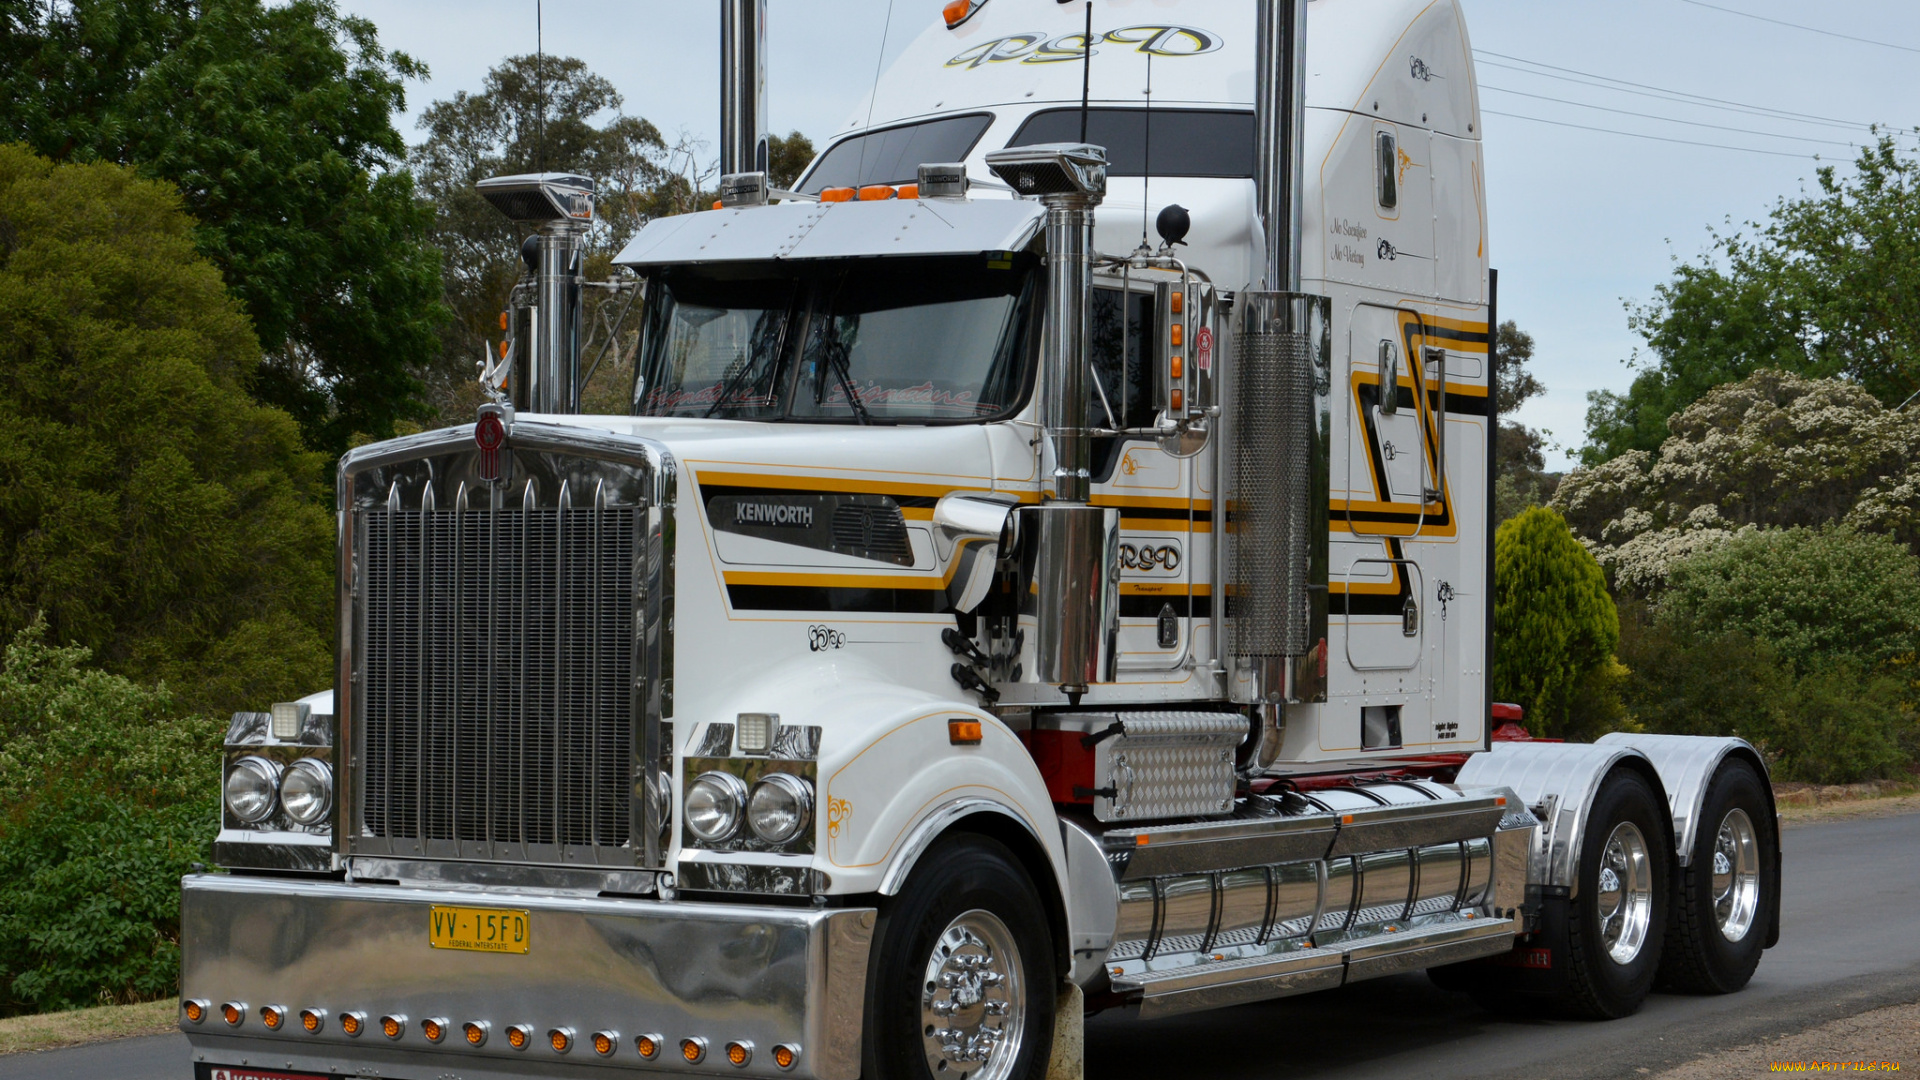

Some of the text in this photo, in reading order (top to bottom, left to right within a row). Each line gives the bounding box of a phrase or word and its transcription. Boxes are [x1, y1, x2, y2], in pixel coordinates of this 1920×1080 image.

[943, 24, 1224, 70] RSD
[1330, 217, 1367, 241] No Sacrifice
[1331, 244, 1342, 261] No
[827, 380, 1001, 413] Signature
[736, 502, 813, 524] KENWORTH
[1119, 543, 1181, 572] RSD
[1134, 584, 1163, 592] Transport
[449, 940, 508, 950] FEDERAL INTERSTATE
